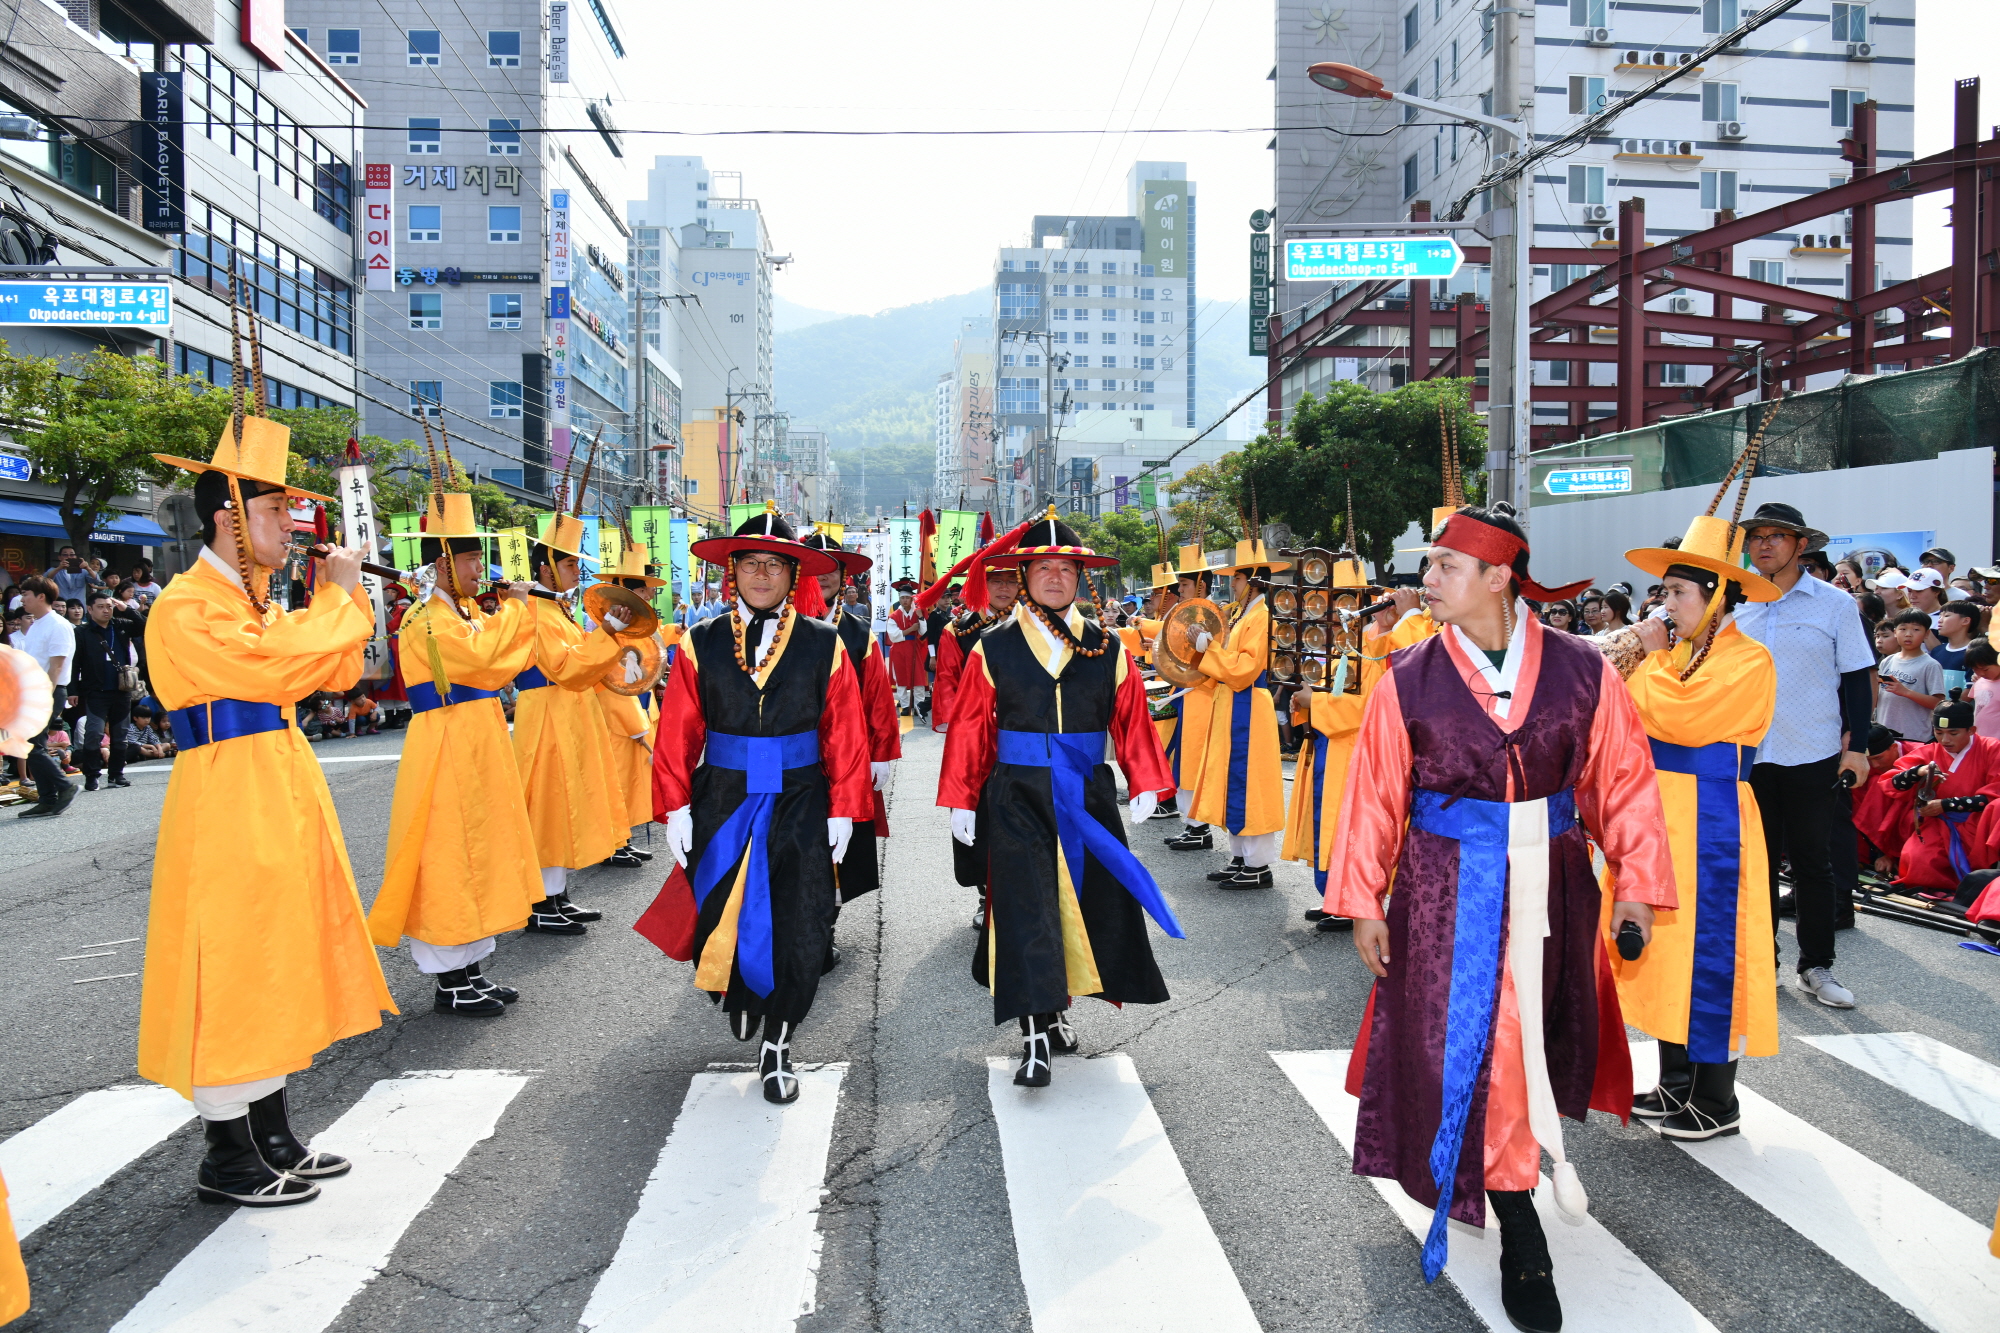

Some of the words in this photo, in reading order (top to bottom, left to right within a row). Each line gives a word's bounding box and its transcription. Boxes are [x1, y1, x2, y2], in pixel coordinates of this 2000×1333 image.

[552, 5, 566, 31] Beer
[552, 37, 566, 71] Bake's
[156, 77, 168, 125] PARIS
[157, 132, 170, 218] BAGUETTE
[404, 165, 522, 196] 거제치과
[368, 204, 391, 270] 다이소
[1160, 216, 1174, 272] 에이원
[1290, 242, 1405, 262] 옥포대첩로5길
[1253, 236, 1269, 307] 에버그린
[1291, 263, 1388, 277] Okpodaecheop-ro
[1391, 262, 1418, 276] 5-gil
[43, 287, 166, 308] 옥포대첩로4길
[29, 308, 133, 322] Okpodaecheop-ro
[136, 309, 166, 324] 4-gil
[729, 313, 744, 323] 101
[1160, 288, 1174, 371] 오피스텔
[1252, 318, 1267, 351] 모텔
[555, 322, 566, 408] 대우아동병원
[94, 532, 126, 543] BAGUETTE
